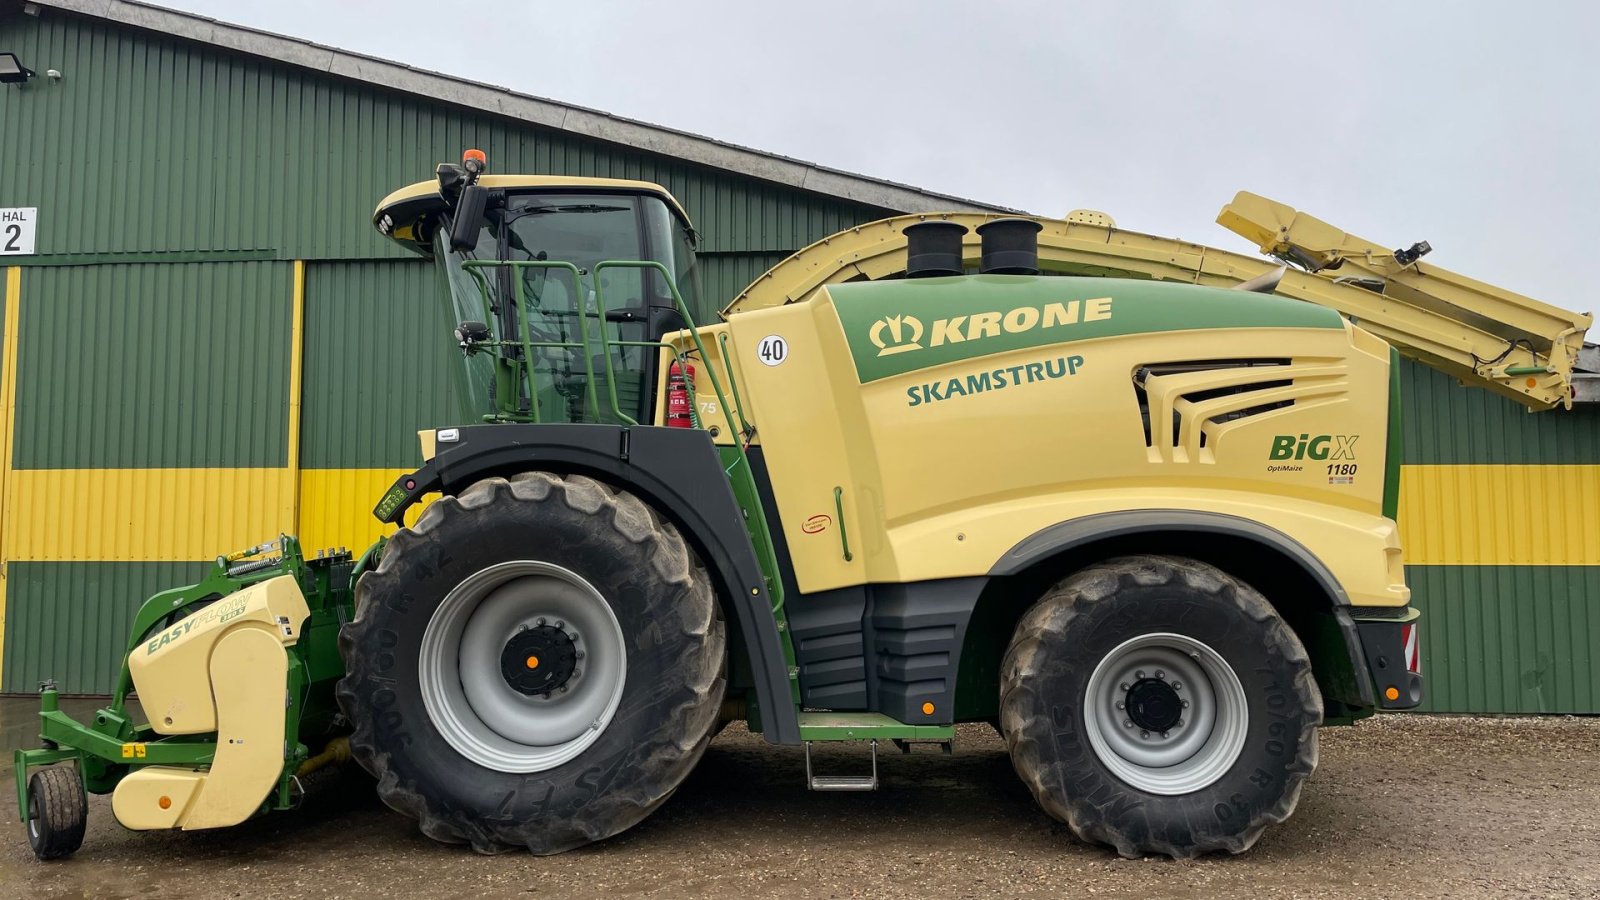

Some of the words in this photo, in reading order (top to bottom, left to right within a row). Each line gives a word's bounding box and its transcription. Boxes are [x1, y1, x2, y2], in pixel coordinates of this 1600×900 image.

[3, 212, 27, 221] HAL
[4, 224, 21, 251] 2
[930, 297, 1112, 347] KRONE
[762, 340, 783, 360] 40
[907, 355, 1084, 406] SKAMSTRUP
[700, 402, 716, 414] 75
[1327, 464, 1357, 475] 1180
[1213, 790, 1250, 823] 30
